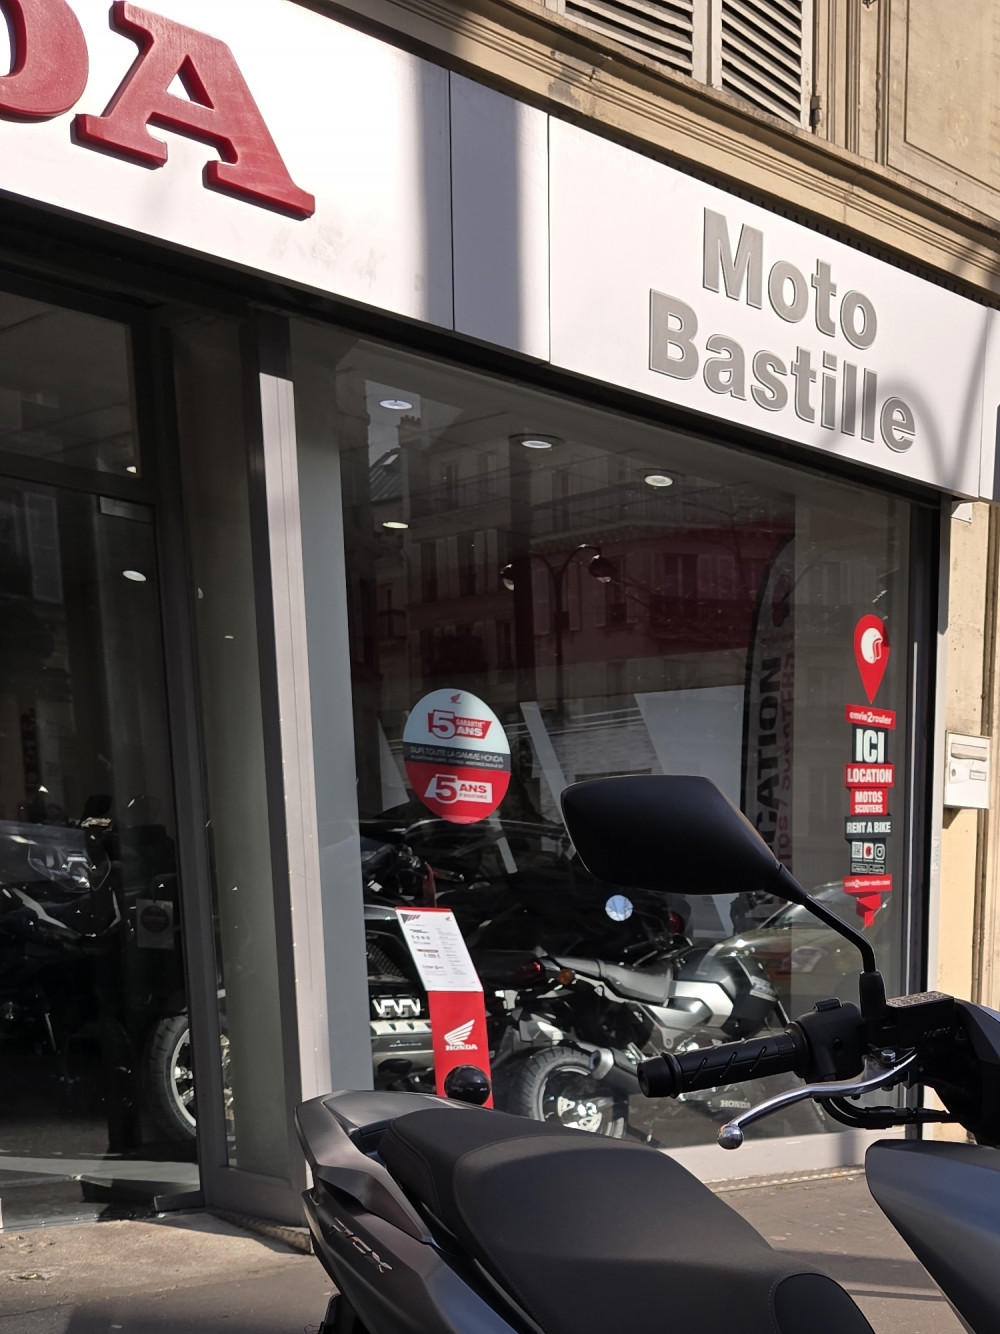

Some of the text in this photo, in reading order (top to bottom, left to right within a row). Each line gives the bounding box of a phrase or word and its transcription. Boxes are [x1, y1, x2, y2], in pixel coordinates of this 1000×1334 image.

[703, 207, 877, 350] Moto
[649, 288, 916, 453] Bastille
[432, 709, 456, 739] 5
[457, 727, 483, 737] ANS
[756, 657, 781, 852] CATION
[856, 728, 885, 763] ICI
[435, 774, 458, 804] 5
[459, 783, 487, 793] ANS
[847, 768, 892, 783] LOCATION
[855, 791, 883, 803] MOTOS
[846, 821, 891, 834] RENT A BIKE
